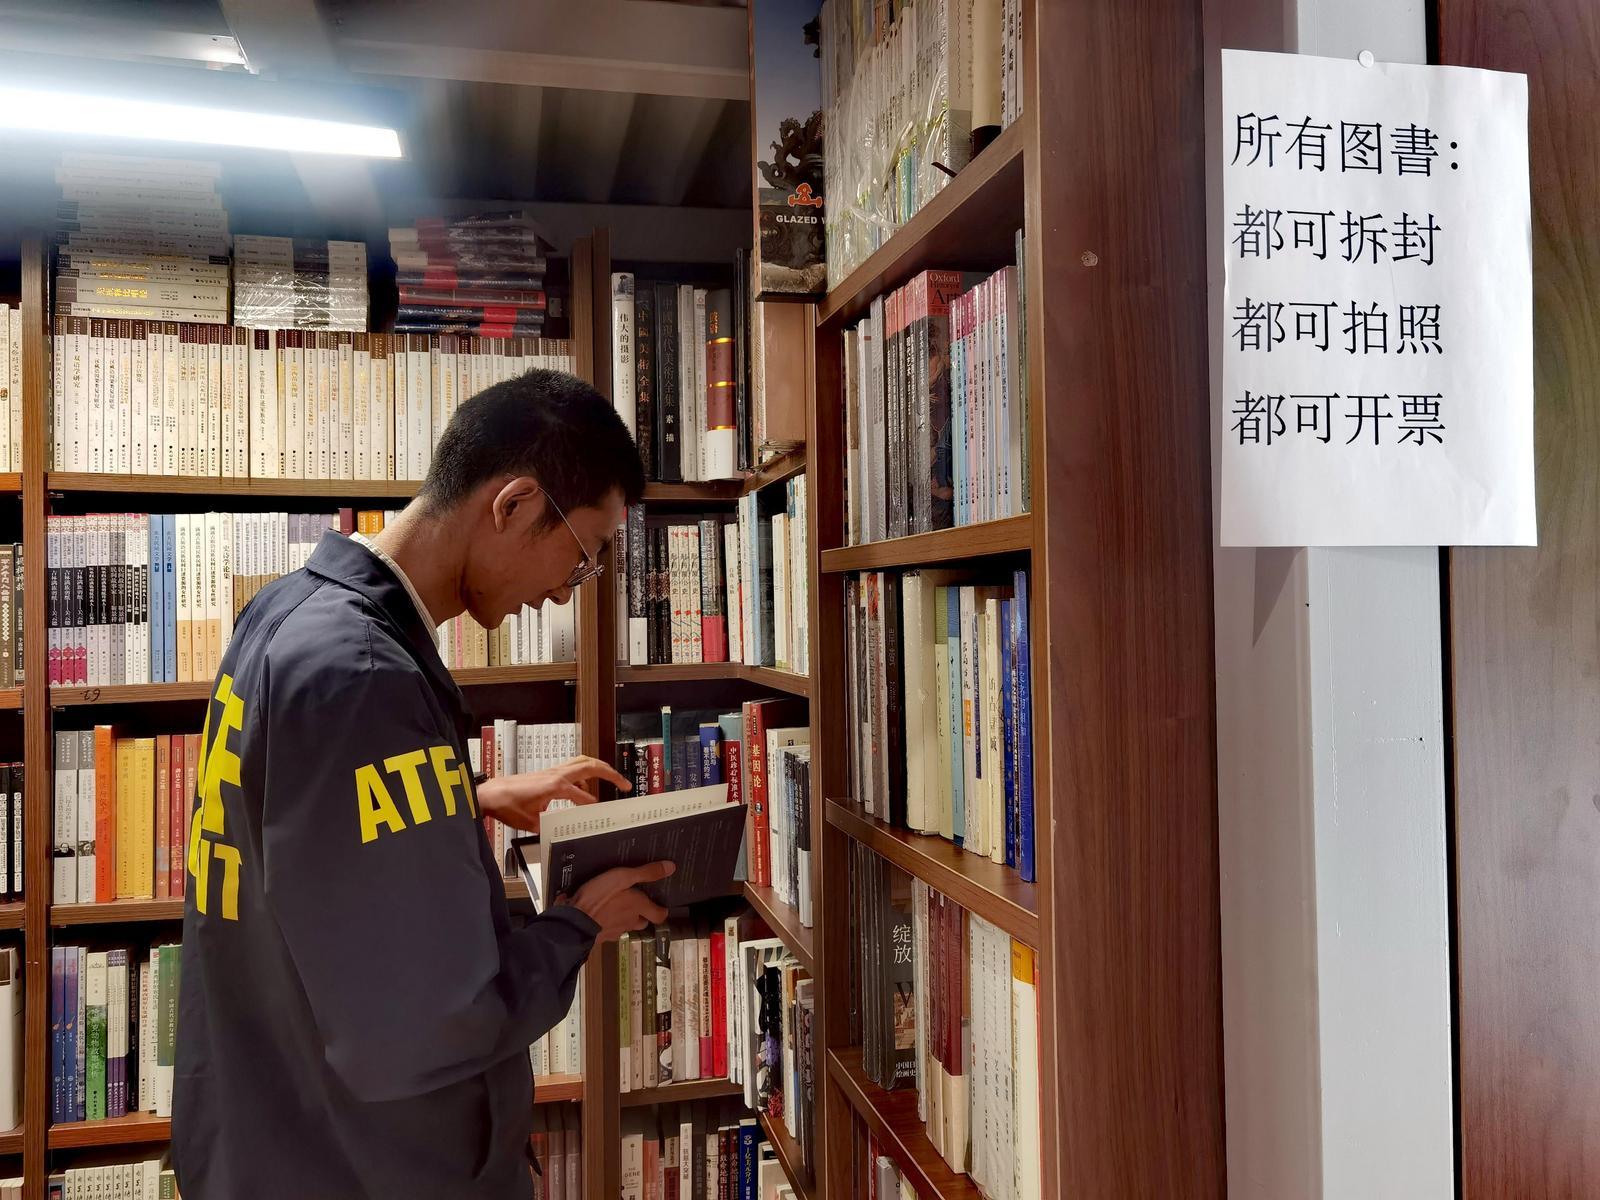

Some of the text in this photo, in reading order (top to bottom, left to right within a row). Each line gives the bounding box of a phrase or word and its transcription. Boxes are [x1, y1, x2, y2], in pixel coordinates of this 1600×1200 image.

[776, 214, 817, 225] GLAZED
[1231, 204, 1442, 266] 都可拆封
[929, 271, 960, 283] Oxford
[619, 313, 629, 364] 伟大的摄影
[1231, 297, 1443, 354] 都可拍照
[1231, 390, 1446, 446] 都可开票
[752, 744, 762, 788] 基因论
[892, 924, 912, 964] 绽放
